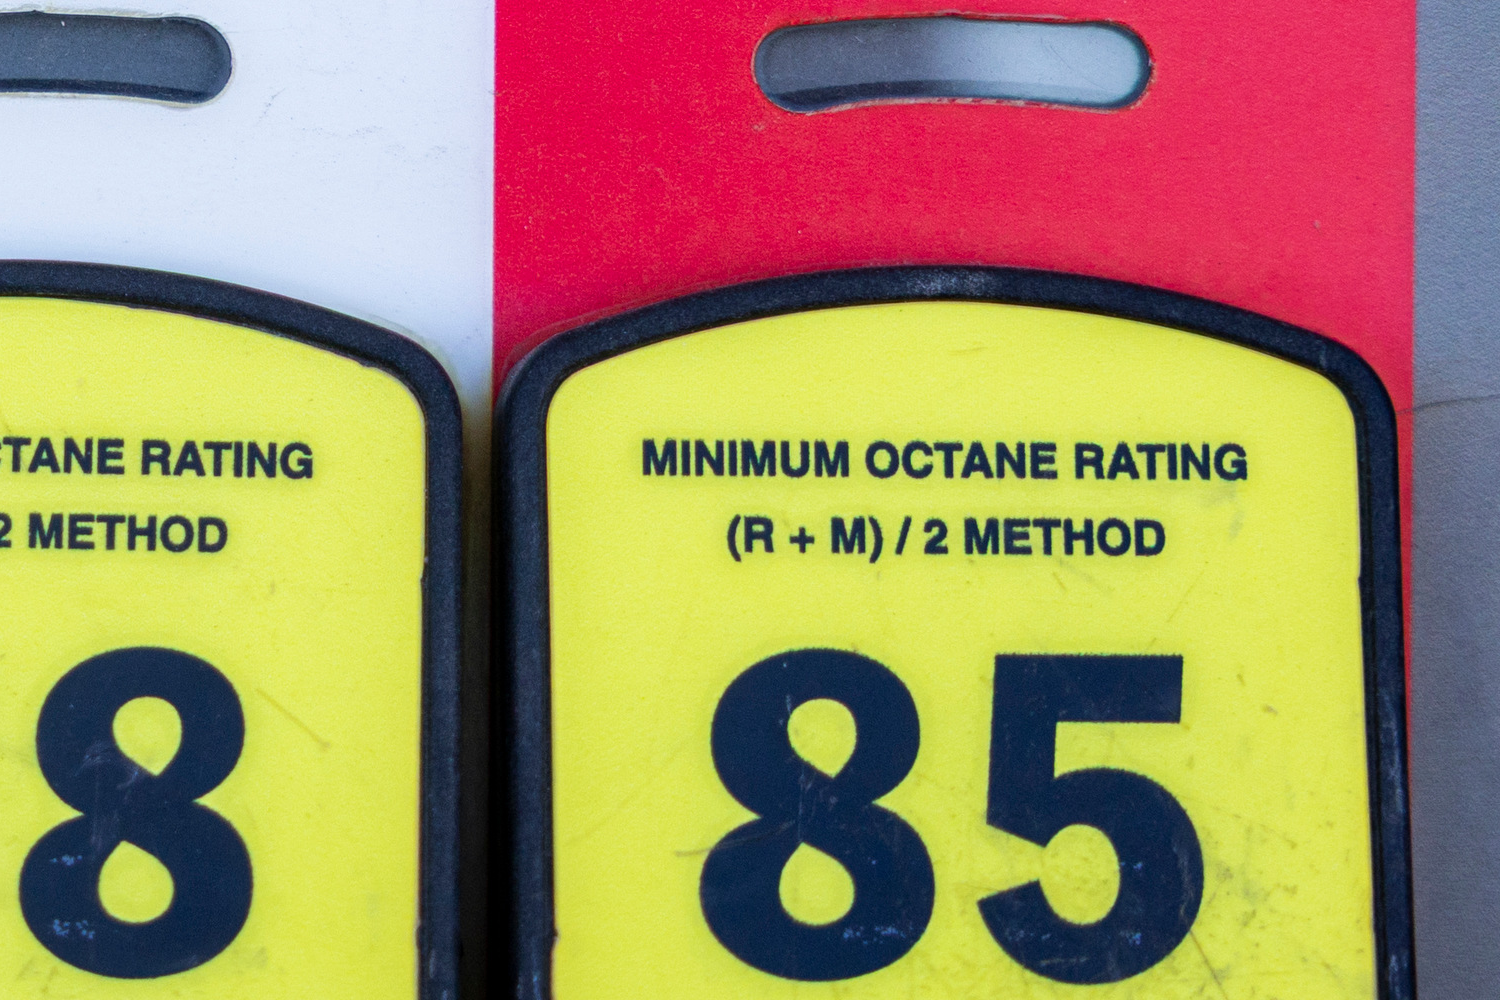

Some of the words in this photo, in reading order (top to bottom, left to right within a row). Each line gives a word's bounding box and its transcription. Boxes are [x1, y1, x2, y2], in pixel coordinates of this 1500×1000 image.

[140, 439, 313, 479] RATING
[641, 438, 849, 479] MINIMUM
[865, 441, 1058, 480] OCTANE
[1074, 441, 1248, 481] RATING
[28, 513, 227, 553] METHOD
[727, 514, 775, 561] (R
[790, 525, 816, 552] +
[831, 516, 884, 562] M)
[895, 518, 912, 555] /
[923, 519, 948, 555] 2
[965, 518, 1166, 557] METHOD
[700, 647, 1205, 985] 85
